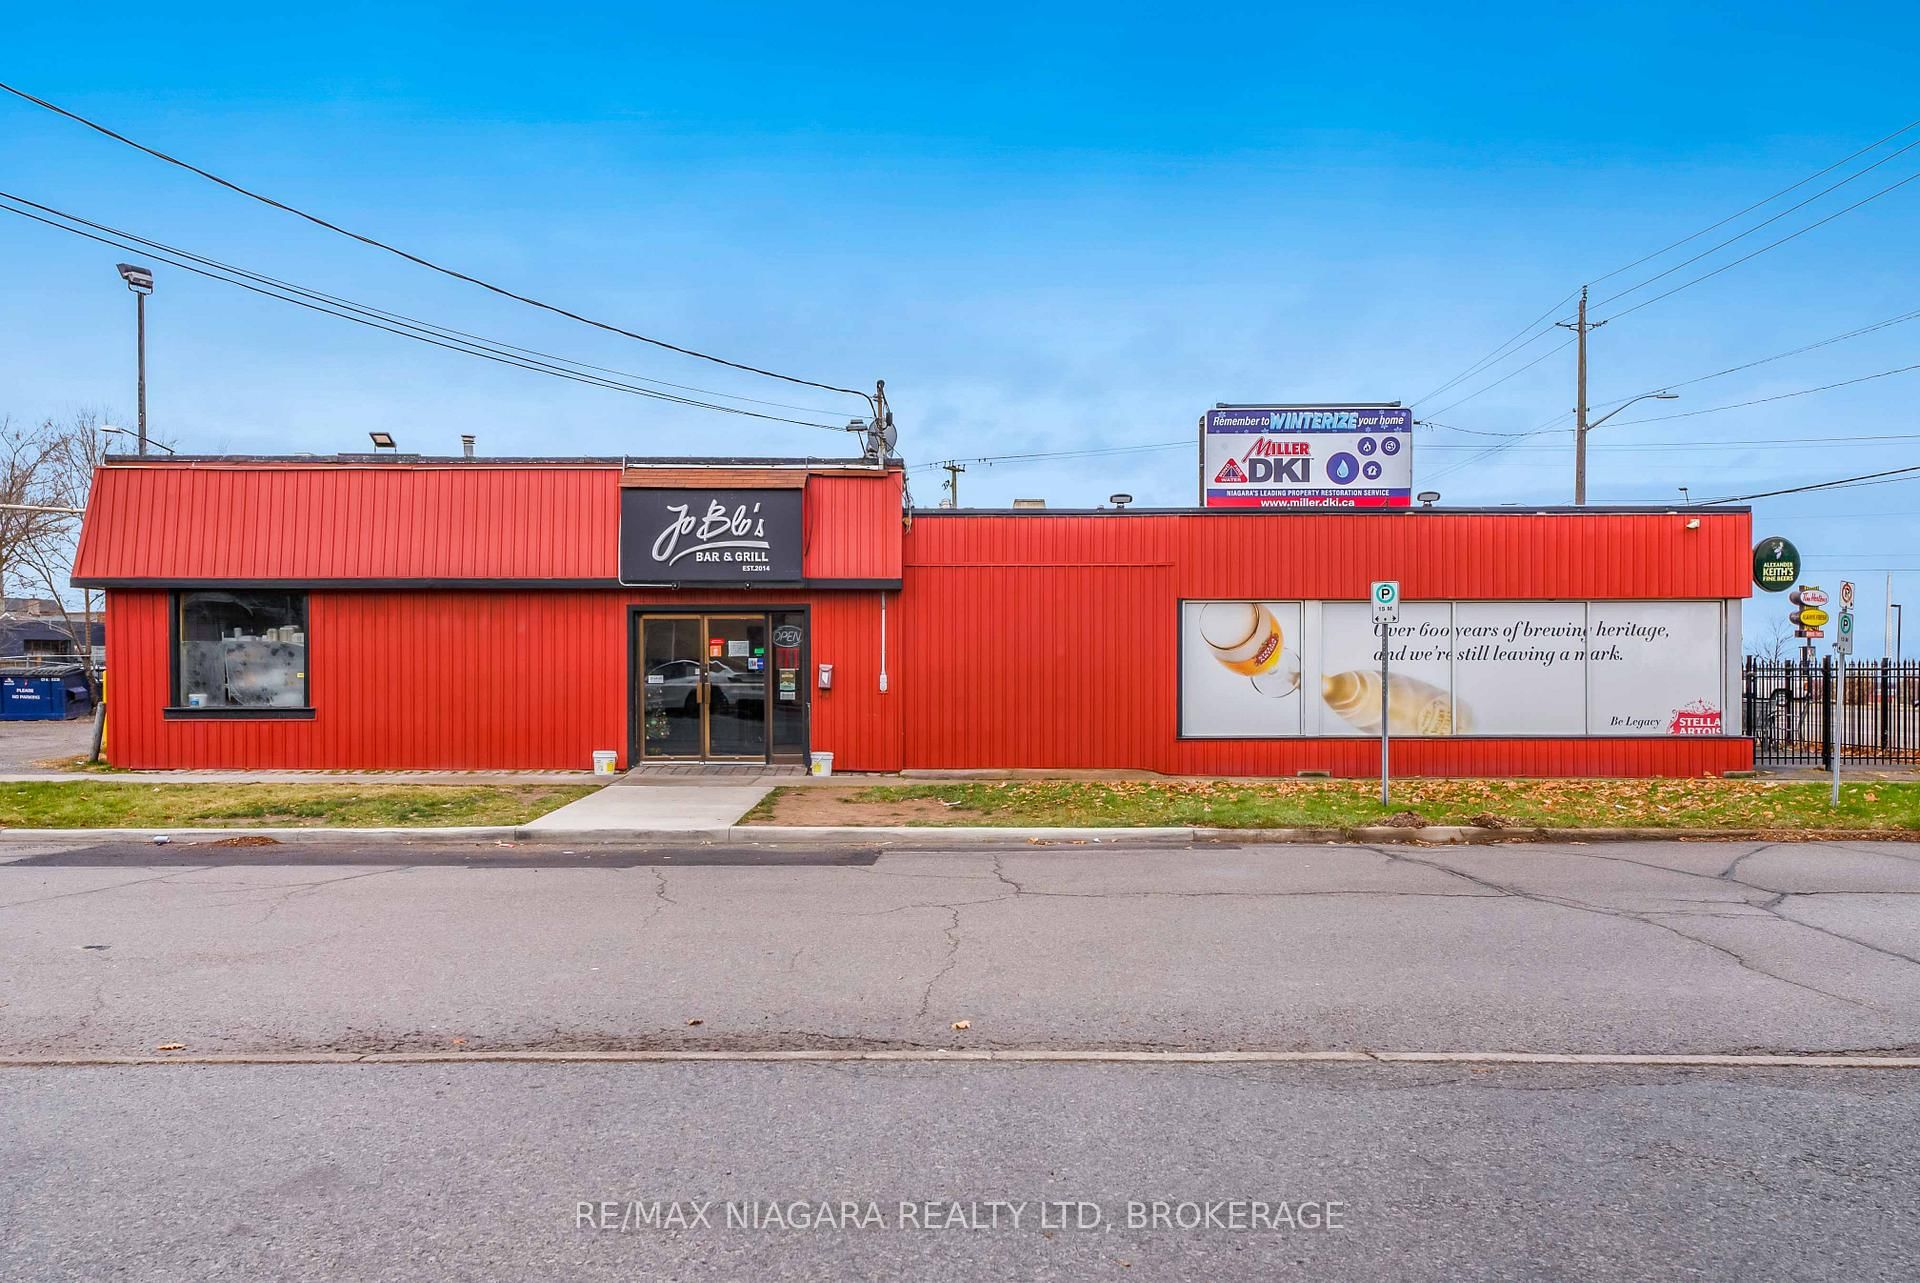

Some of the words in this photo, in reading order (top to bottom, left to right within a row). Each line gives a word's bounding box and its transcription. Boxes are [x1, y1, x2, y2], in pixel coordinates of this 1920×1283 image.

[1213, 416, 1260, 426] Remember
[1261, 416, 1270, 426] to
[1270, 412, 1358, 430] WINTERIZE
[1357, 416, 1379, 427] your
[1379, 415, 1404, 425] home
[1249, 458, 1310, 483] DKI
[1260, 498, 1355, 507] www.miller.dki.ca
[652, 504, 696, 562] Jo
[696, 499, 765, 541] Blo's
[696, 552, 720, 562] BAR
[723, 552, 733, 562] &
[735, 552, 768, 562] GRILL
[1763, 567, 1794, 576] KEITH'S
[1381, 588, 1390, 599] P
[775, 631, 800, 642] OPEN
[1419, 621, 1450, 637] 600
[1455, 626, 1499, 640] years
[1502, 620, 1524, 642] of
[1596, 620, 1669, 642] heritage,
[1373, 644, 1407, 661] and
[1409, 645, 1452, 661] we're
[1456, 644, 1490, 661] still
[1492, 644, 1556, 667] leaving
[1559, 650, 1570, 661] a
[1610, 715, 1623, 726] Be
[1625, 716, 1661, 729] Legacy
[1680, 717, 1720, 726] STELLA
